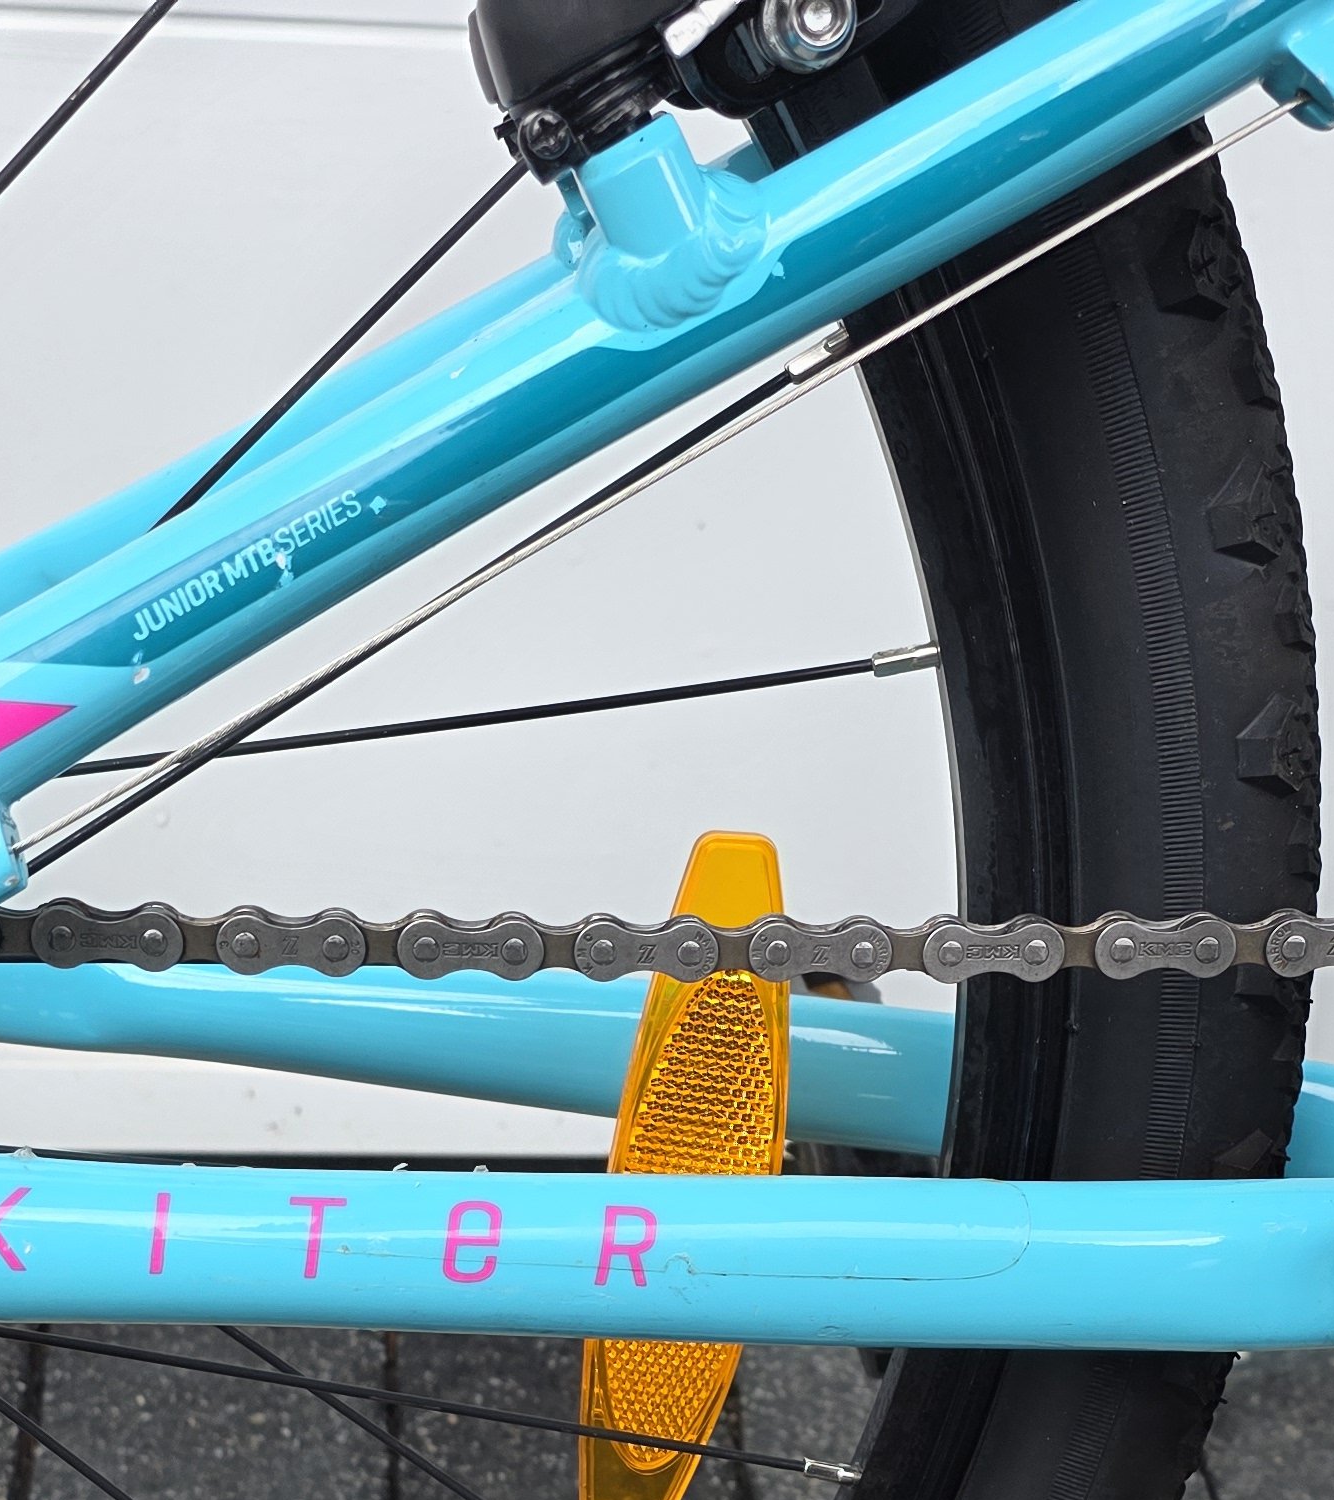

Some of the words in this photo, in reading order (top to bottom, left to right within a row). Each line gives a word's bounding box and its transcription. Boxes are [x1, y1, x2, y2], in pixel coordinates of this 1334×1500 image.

[132, 569, 224, 641] JUNIOR
[221, 537, 278, 587] MTB
[272, 489, 362, 556] SERIES
[80, 933, 137, 950] KMC
[1137, 941, 1193, 959] KMC
[443, 942, 500, 960] KMC
[635, 943, 658, 966] Z
[966, 944, 1021, 961] KMC
